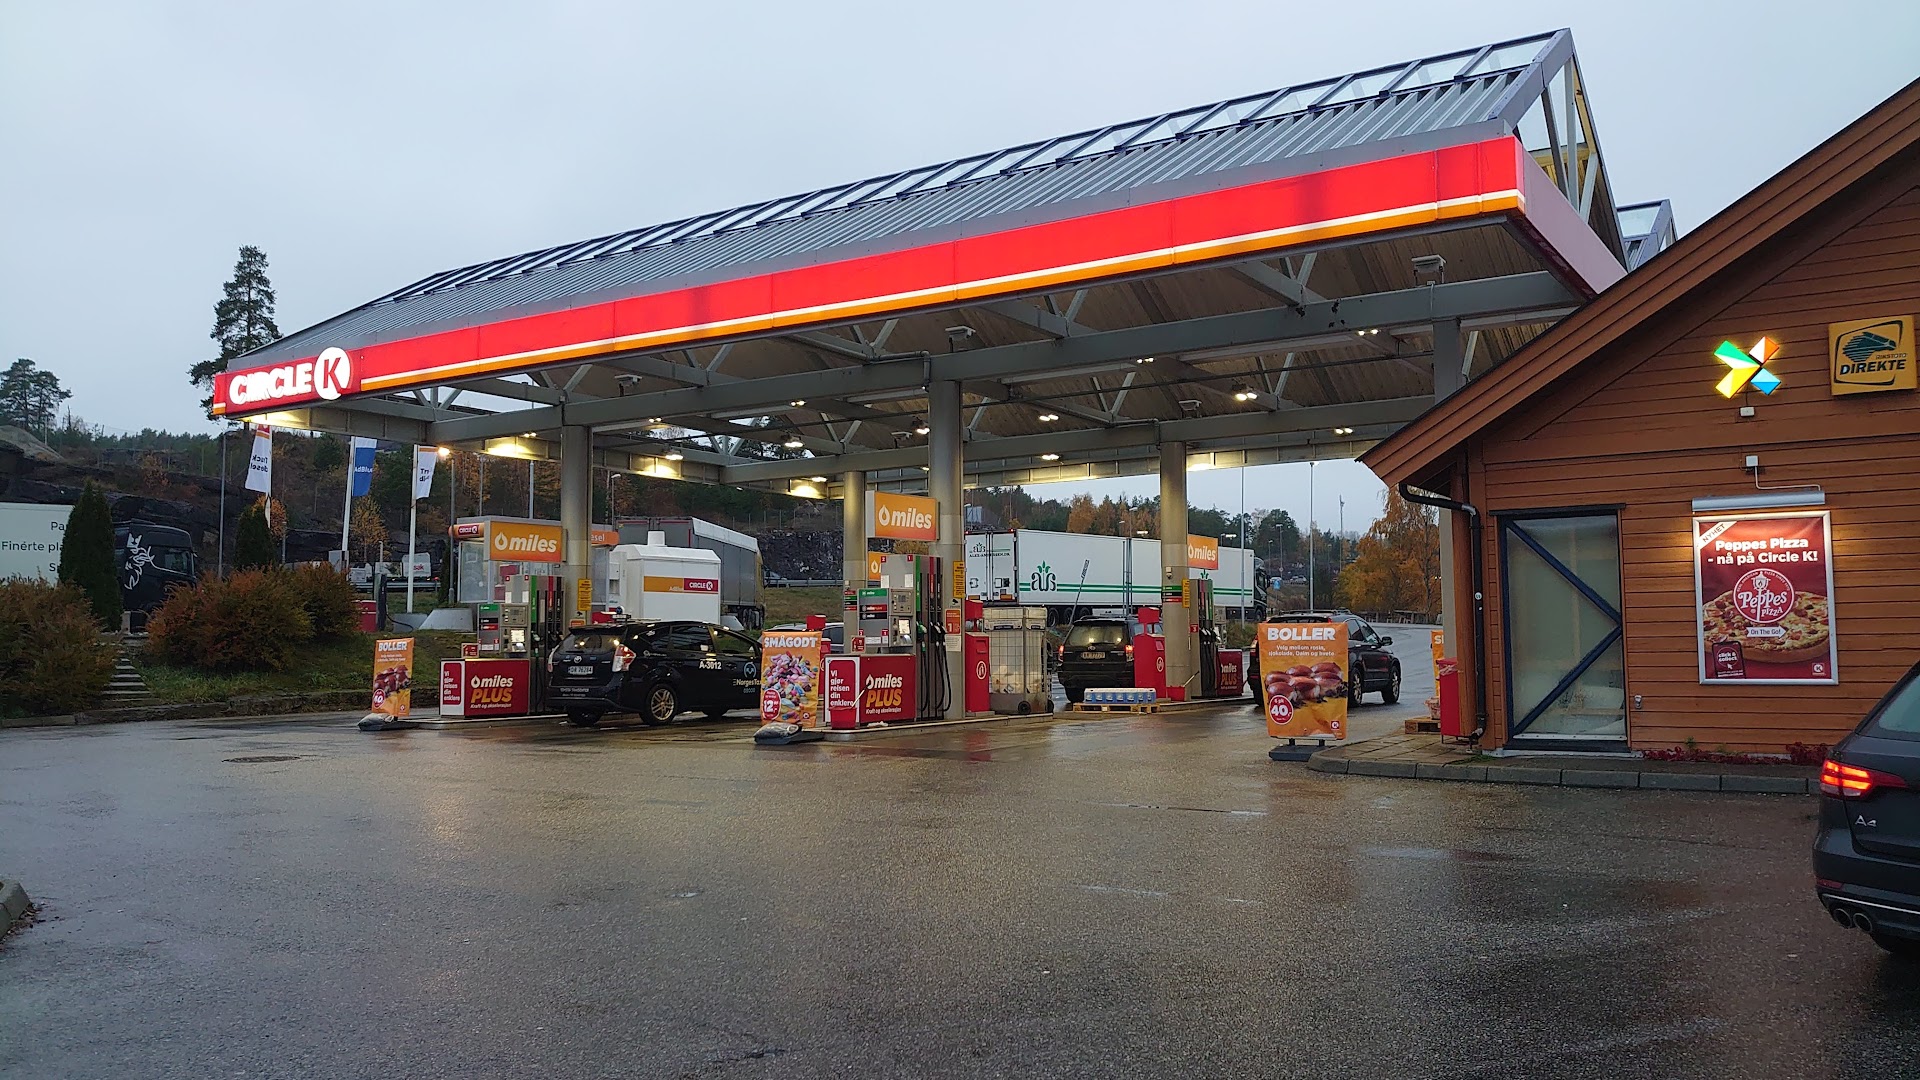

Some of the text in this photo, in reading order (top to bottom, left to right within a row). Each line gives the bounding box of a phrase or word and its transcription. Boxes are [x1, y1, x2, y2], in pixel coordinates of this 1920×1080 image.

[1840, 359, 1907, 375] DIREKTE
[229, 352, 349, 405] CIRCLE K
[891, 508, 932, 529] miles
[1702, 523, 1726, 543] NYHET
[1, 541, 45, 551] Finérte
[509, 534, 557, 552] miles
[1715, 537, 1809, 552] Peppes Pizza
[1194, 546, 1216, 561] miles
[1717, 552, 1734, 564] nå
[1737, 552, 1755, 565] på
[1758, 552, 1799, 563] Circle
[1802, 551, 1818, 562] K!
[706, 581, 713, 590] K
[1737, 590, 1787, 609] Peppes
[764, 635, 818, 648] SMÅGODT
[1267, 627, 1336, 641] BOLLER
[378, 641, 408, 652] BOLLER
[699, 661, 722, 669] A-3012
[480, 674, 514, 688] miles
[874, 674, 903, 689] miles
[470, 688, 513, 704] PLUS
[866, 689, 902, 708] PLUS
[1855, 815, 1877, 827] A4
